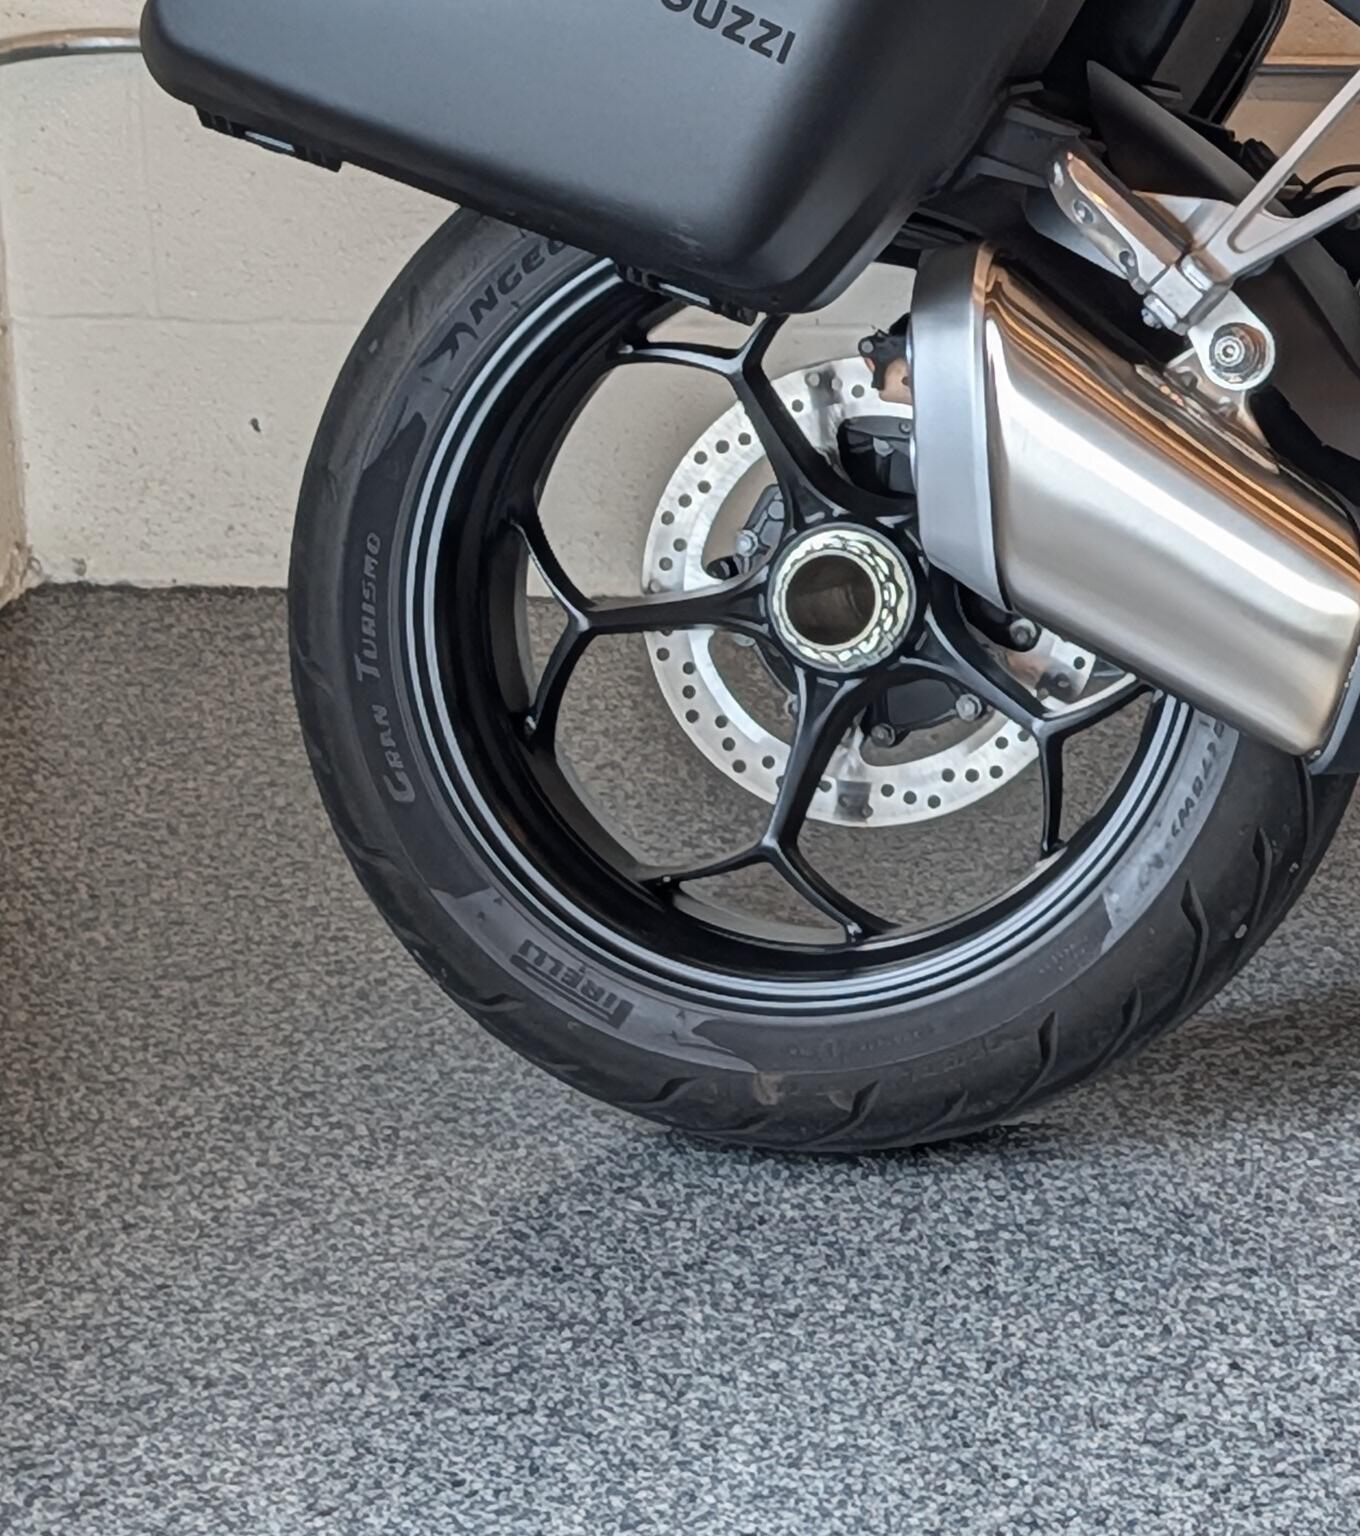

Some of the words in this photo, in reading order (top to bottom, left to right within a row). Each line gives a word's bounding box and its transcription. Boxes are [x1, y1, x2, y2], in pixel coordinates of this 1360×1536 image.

[354, 532, 381, 683] TURISMO
[371, 704, 416, 804] GRAN
[509, 938, 635, 1030] PIRELLI
